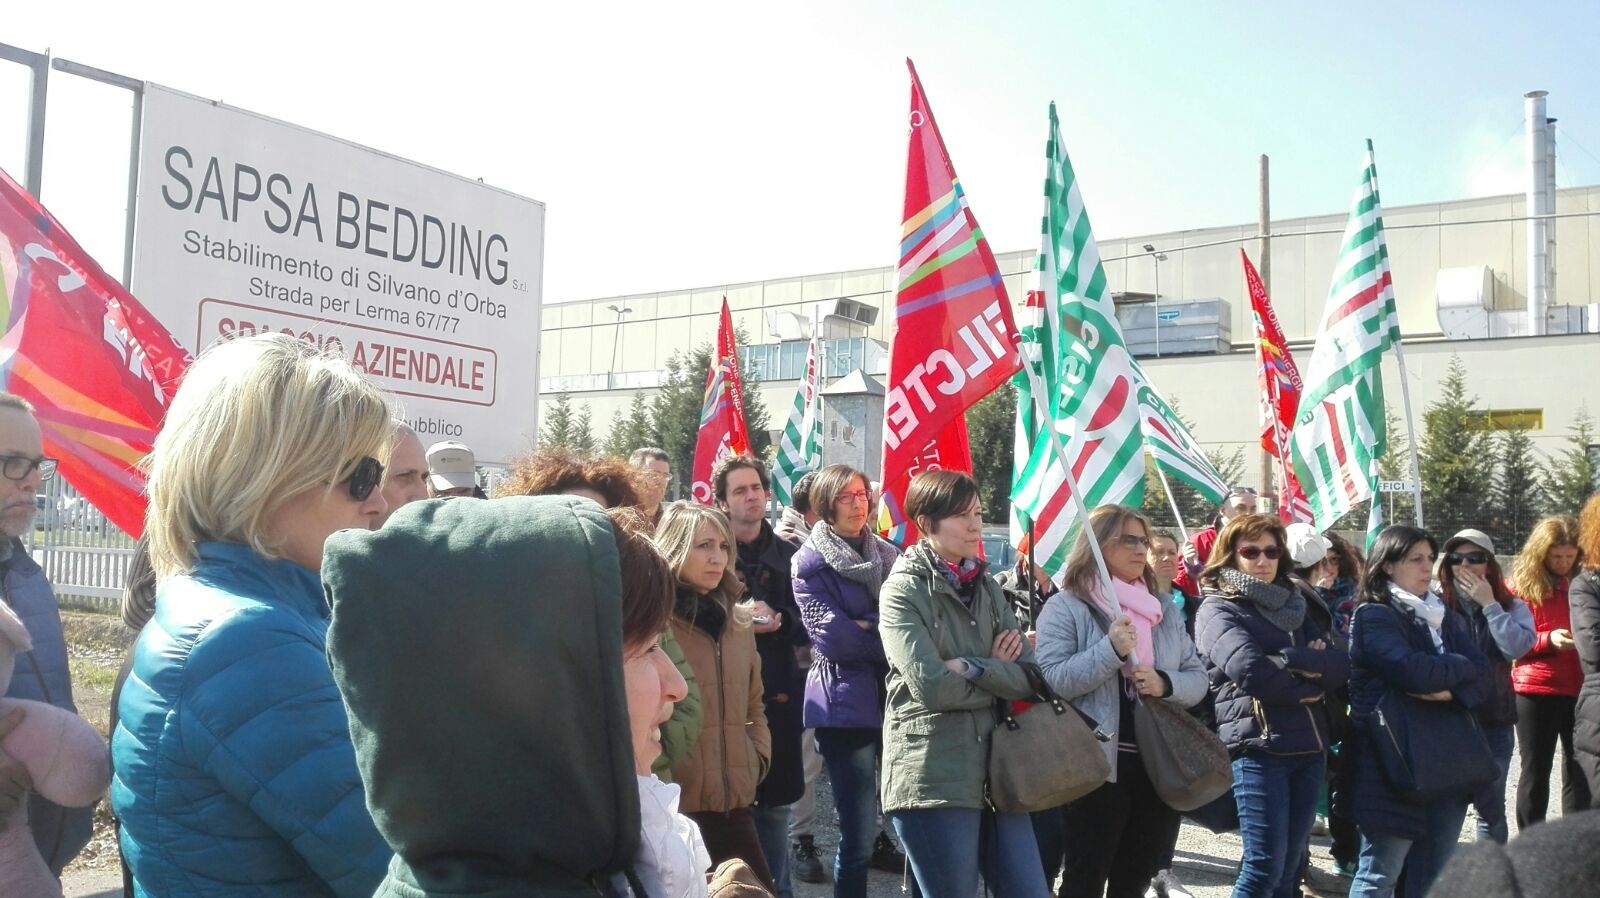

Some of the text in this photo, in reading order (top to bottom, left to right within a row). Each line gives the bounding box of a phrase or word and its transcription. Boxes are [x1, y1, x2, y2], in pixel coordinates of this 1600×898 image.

[161, 145, 324, 243] SAPSA
[335, 191, 508, 286] BEDDING
[183, 229, 507, 319] Stabilimento di Silvano d'Orba
[249, 277, 460, 334] Strada per Lerma 67/77
[352, 341, 485, 391] AZIENDALE
